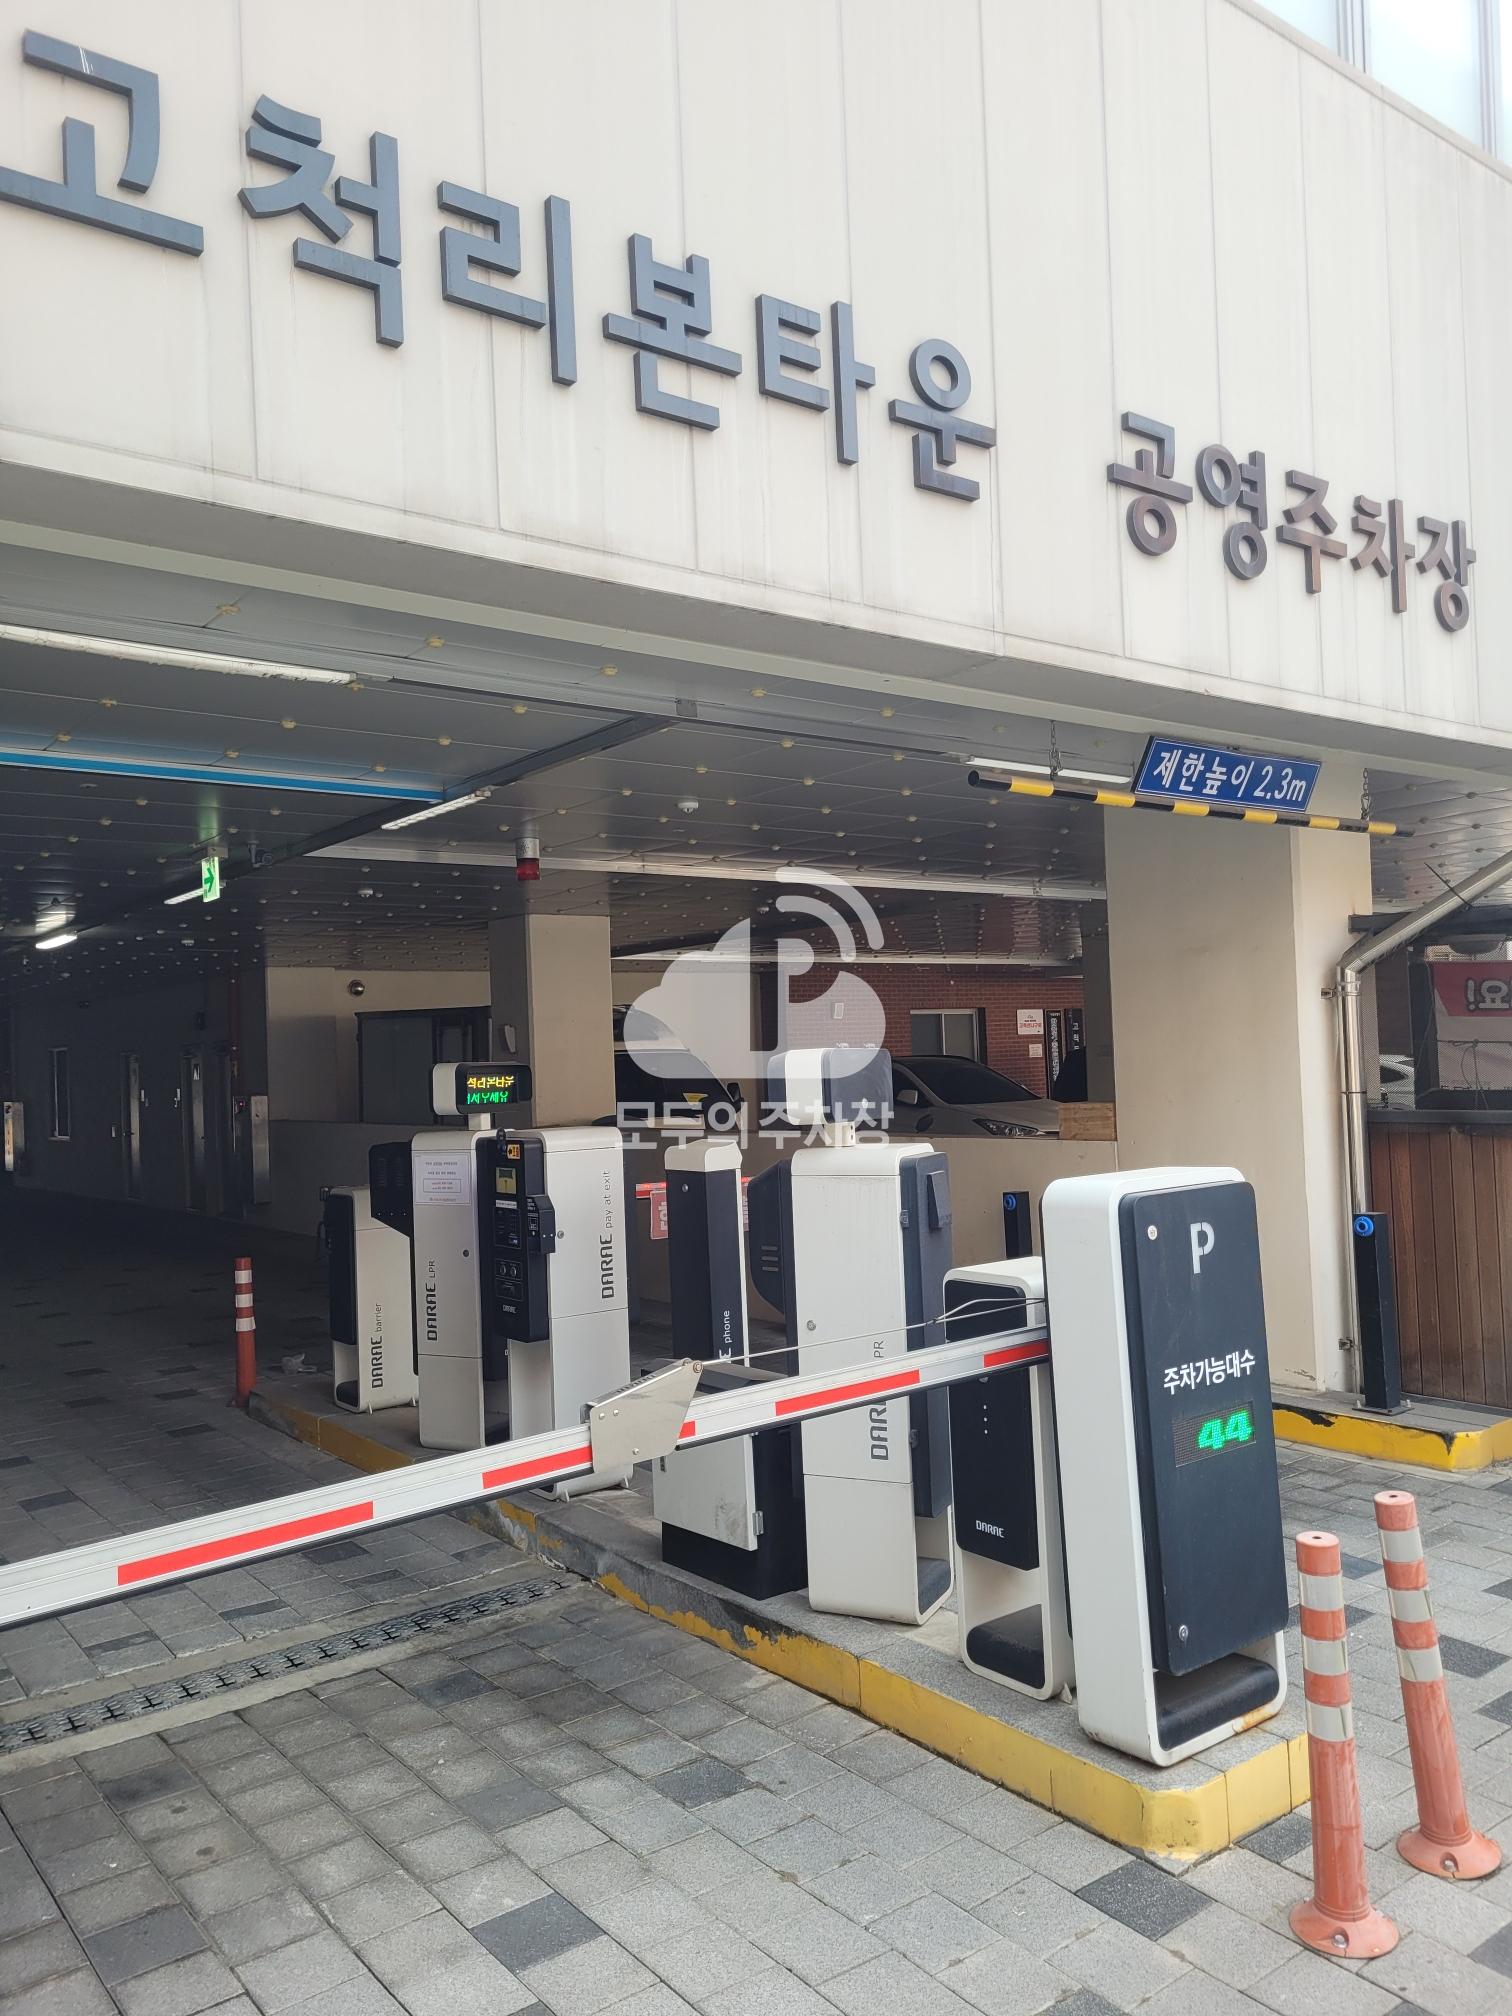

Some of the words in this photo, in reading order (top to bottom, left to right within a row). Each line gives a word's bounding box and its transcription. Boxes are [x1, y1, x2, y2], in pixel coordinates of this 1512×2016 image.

[0, 28, 996, 501] 고척리본타운
[1107, 411, 1476, 632] 공영주차장
[602, 1170, 611, 1191] exit
[603, 1195, 611, 1206] at
[605, 1209, 614, 1229] pay
[1190, 1221, 1215, 1274] P
[428, 1260, 436, 1279] LPR
[599, 1234, 615, 1299] DARAE
[374, 1303, 383, 1333] barrier
[425, 1282, 438, 1341] DARAE
[720, 1310, 733, 1344] phone
[370, 1335, 384, 1389] DARAE
[873, 1339, 885, 1358] PR
[1163, 1348, 1256, 1395] 주차가능대수
[1196, 1408, 1253, 1450] 44
[976, 1519, 1005, 1539] DARAE
